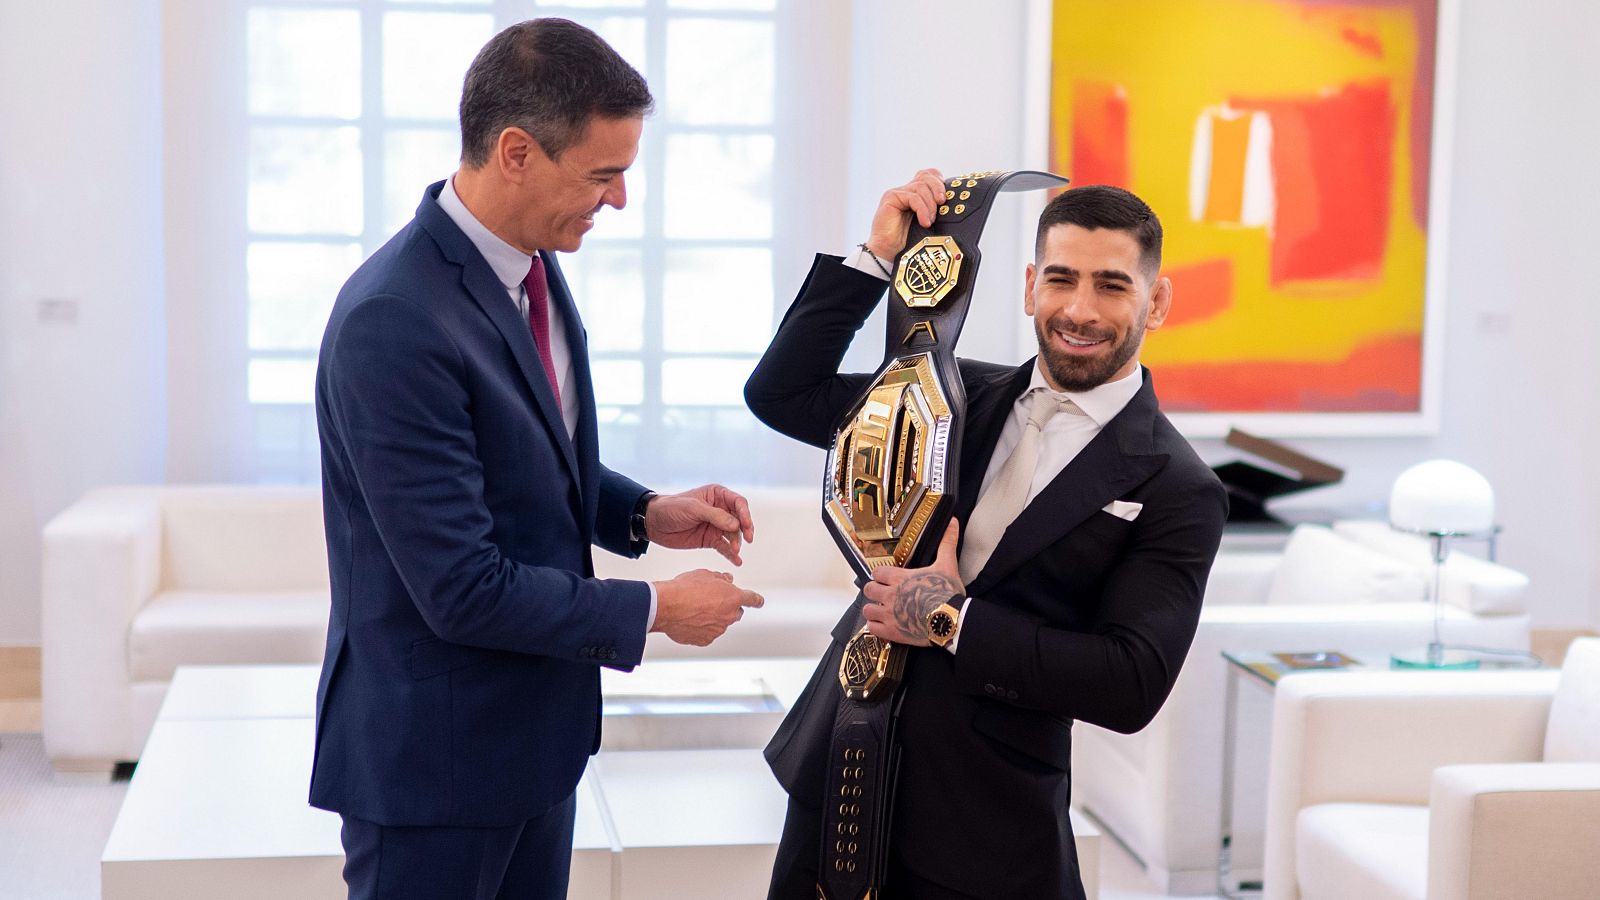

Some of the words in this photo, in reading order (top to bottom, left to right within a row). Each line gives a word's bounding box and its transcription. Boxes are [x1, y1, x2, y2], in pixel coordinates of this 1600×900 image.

[913, 253, 939, 289] CHAMPION
[920, 251, 942, 281] WORLD
[933, 249, 947, 267] UFC
[852, 400, 892, 518] UFC
